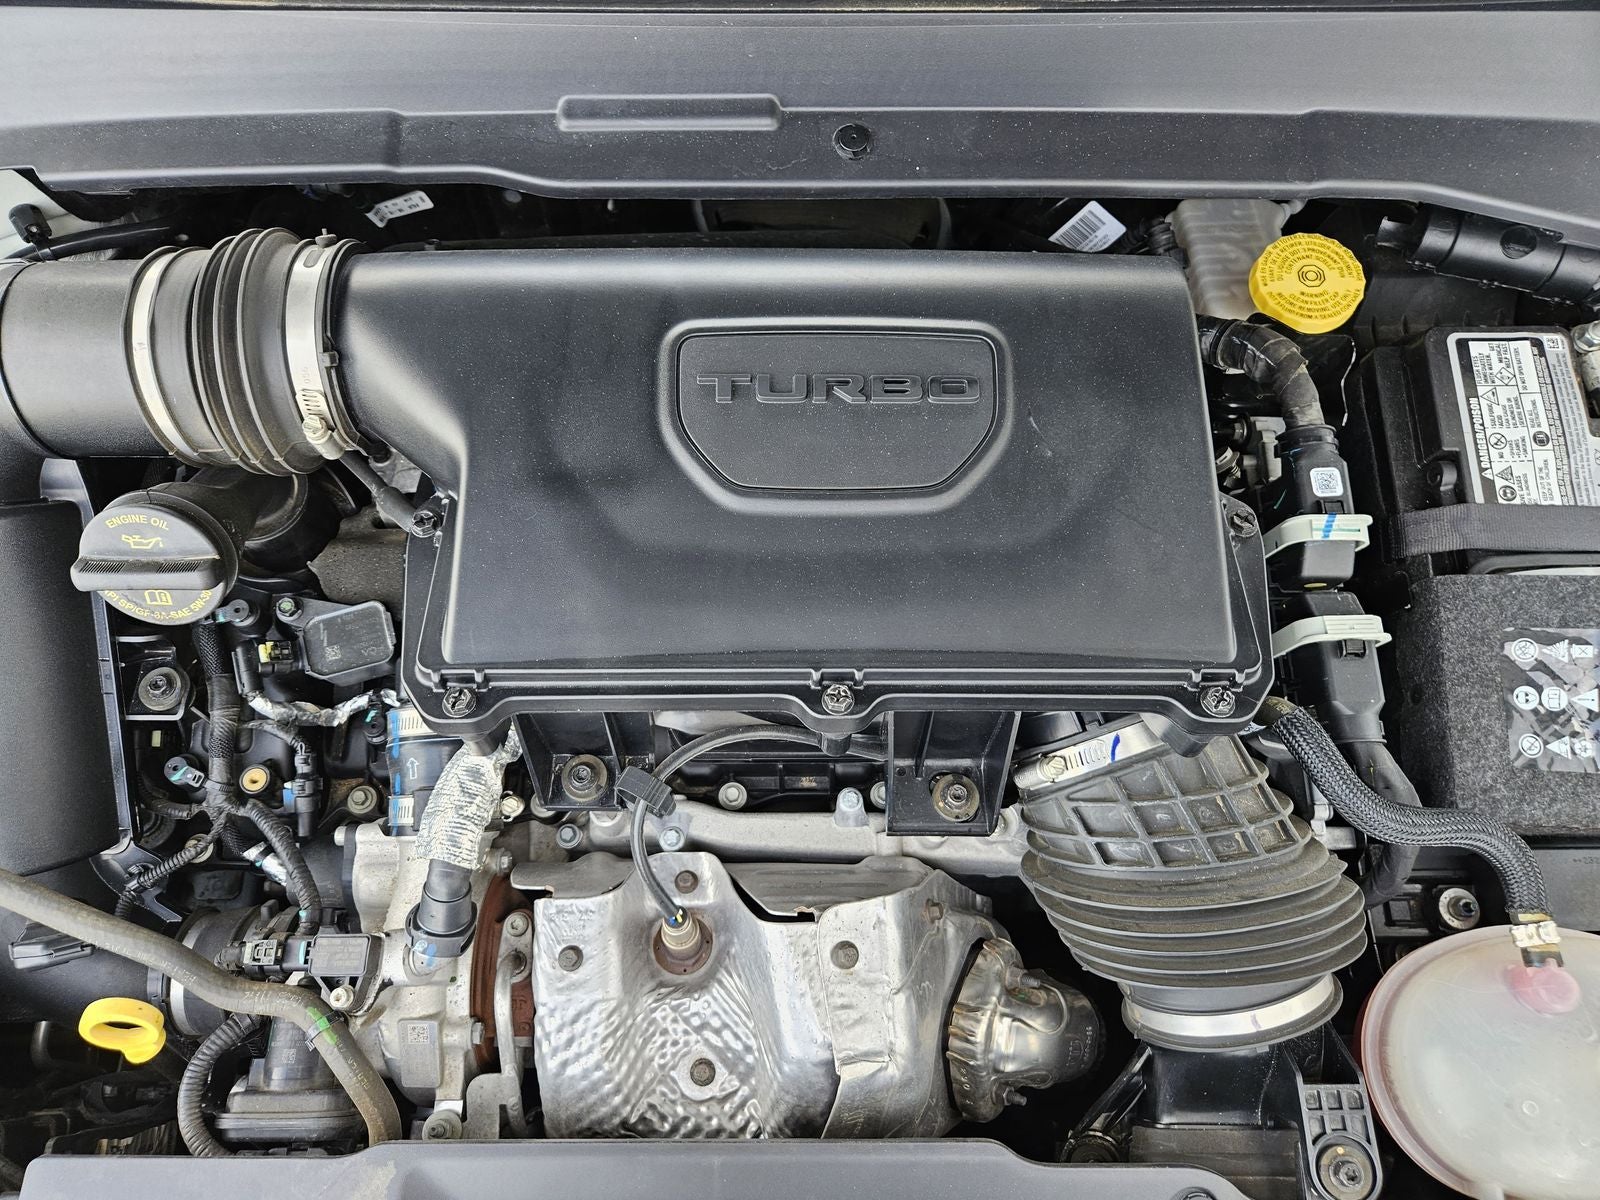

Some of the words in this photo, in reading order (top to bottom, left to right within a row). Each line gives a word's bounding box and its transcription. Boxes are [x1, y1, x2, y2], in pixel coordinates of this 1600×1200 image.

[1472, 355, 1480, 368] EYES
[1495, 343, 1503, 364] MEDICAL
[1475, 368, 1483, 384] FLUSH
[1478, 352, 1489, 384] IMMEDIATELY
[1488, 371, 1496, 384] WITH
[697, 374, 980, 403] TURBO
[1468, 397, 1492, 469] DANGER/POISON
[105, 514, 148, 529] ENGINE
[150, 517, 169, 531] OIL
